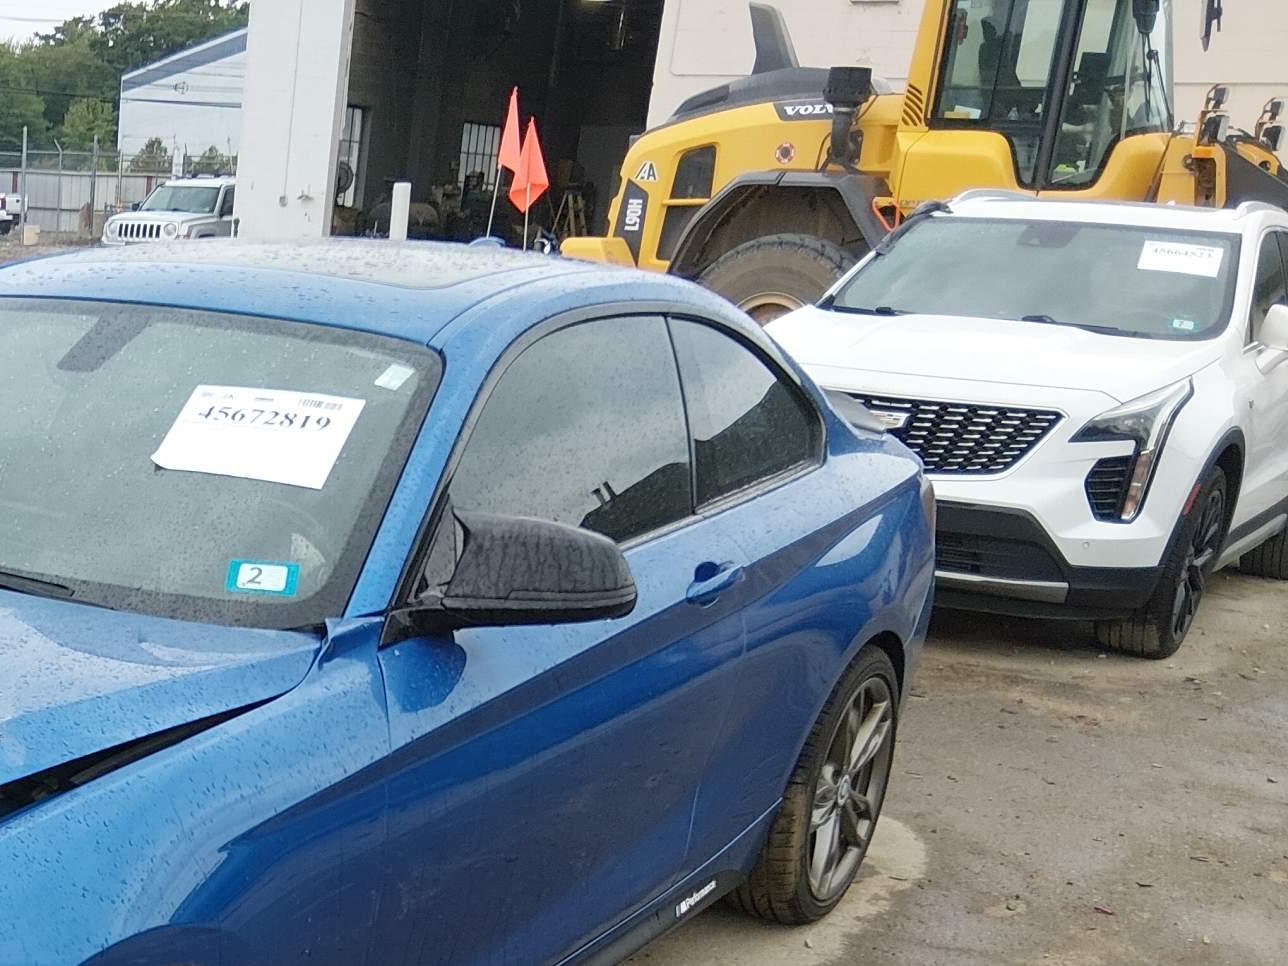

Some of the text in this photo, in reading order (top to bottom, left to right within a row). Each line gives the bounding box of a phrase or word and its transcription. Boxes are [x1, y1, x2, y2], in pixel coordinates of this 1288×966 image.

[784, 103, 833, 116] VOLV
[624, 198, 643, 231] L90H
[198, 405, 331, 431] 45672819
[247, 566, 263, 585] 2
